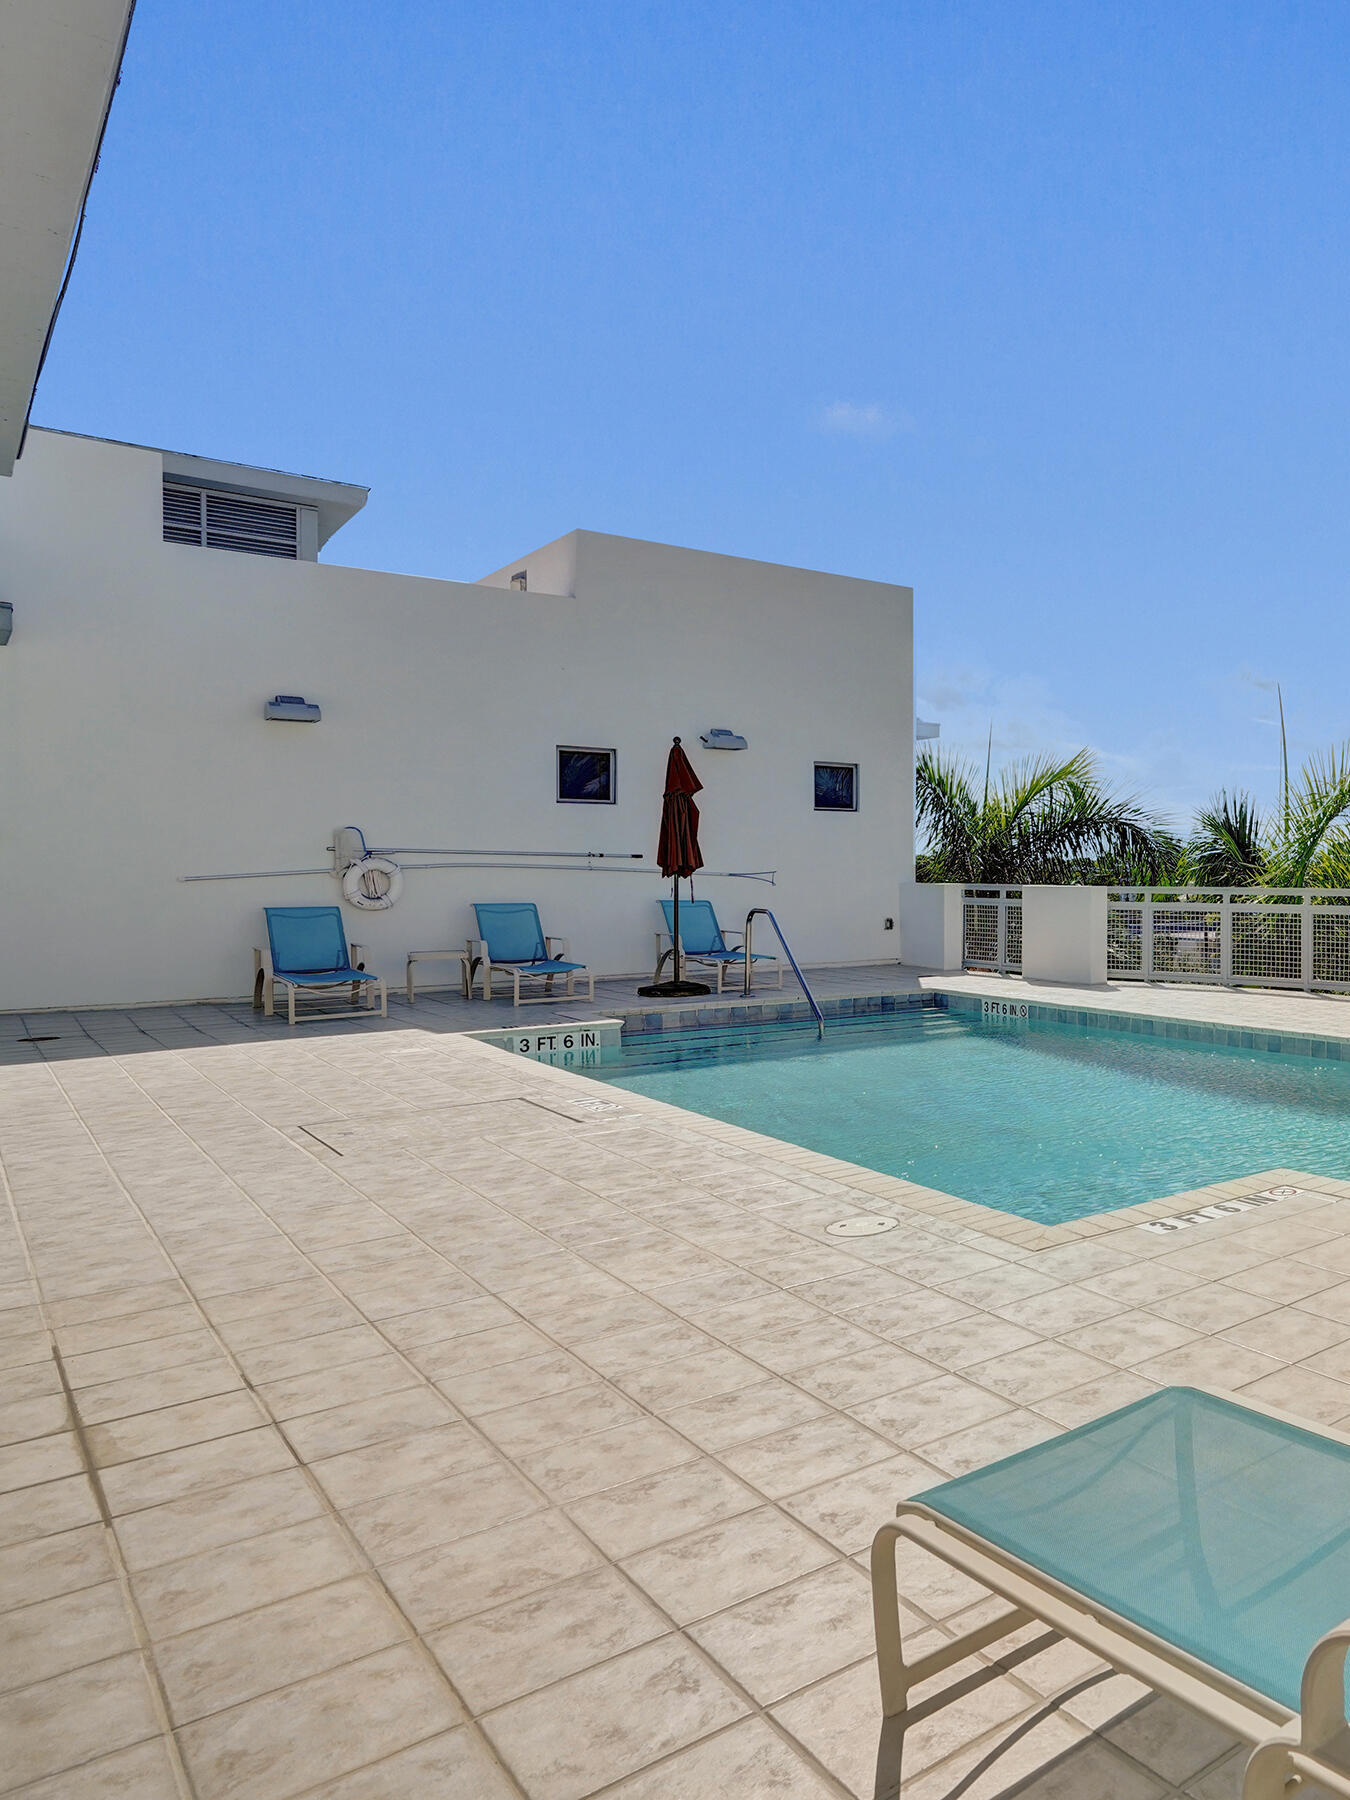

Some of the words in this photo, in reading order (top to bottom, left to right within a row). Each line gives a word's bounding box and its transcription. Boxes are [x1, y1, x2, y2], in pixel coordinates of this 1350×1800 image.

[984, 1001, 989, 1012] 3
[1002, 1003, 1008, 1015] 6
[1009, 1004, 1019, 1017] IN.
[519, 1038, 530, 1053] 3
[537, 1036, 557, 1051] FT.
[563, 1034, 574, 1049] 6
[581, 1032, 600, 1047] IN.
[1149, 1221, 1178, 1231] 3
[1213, 1205, 1241, 1213] 6
